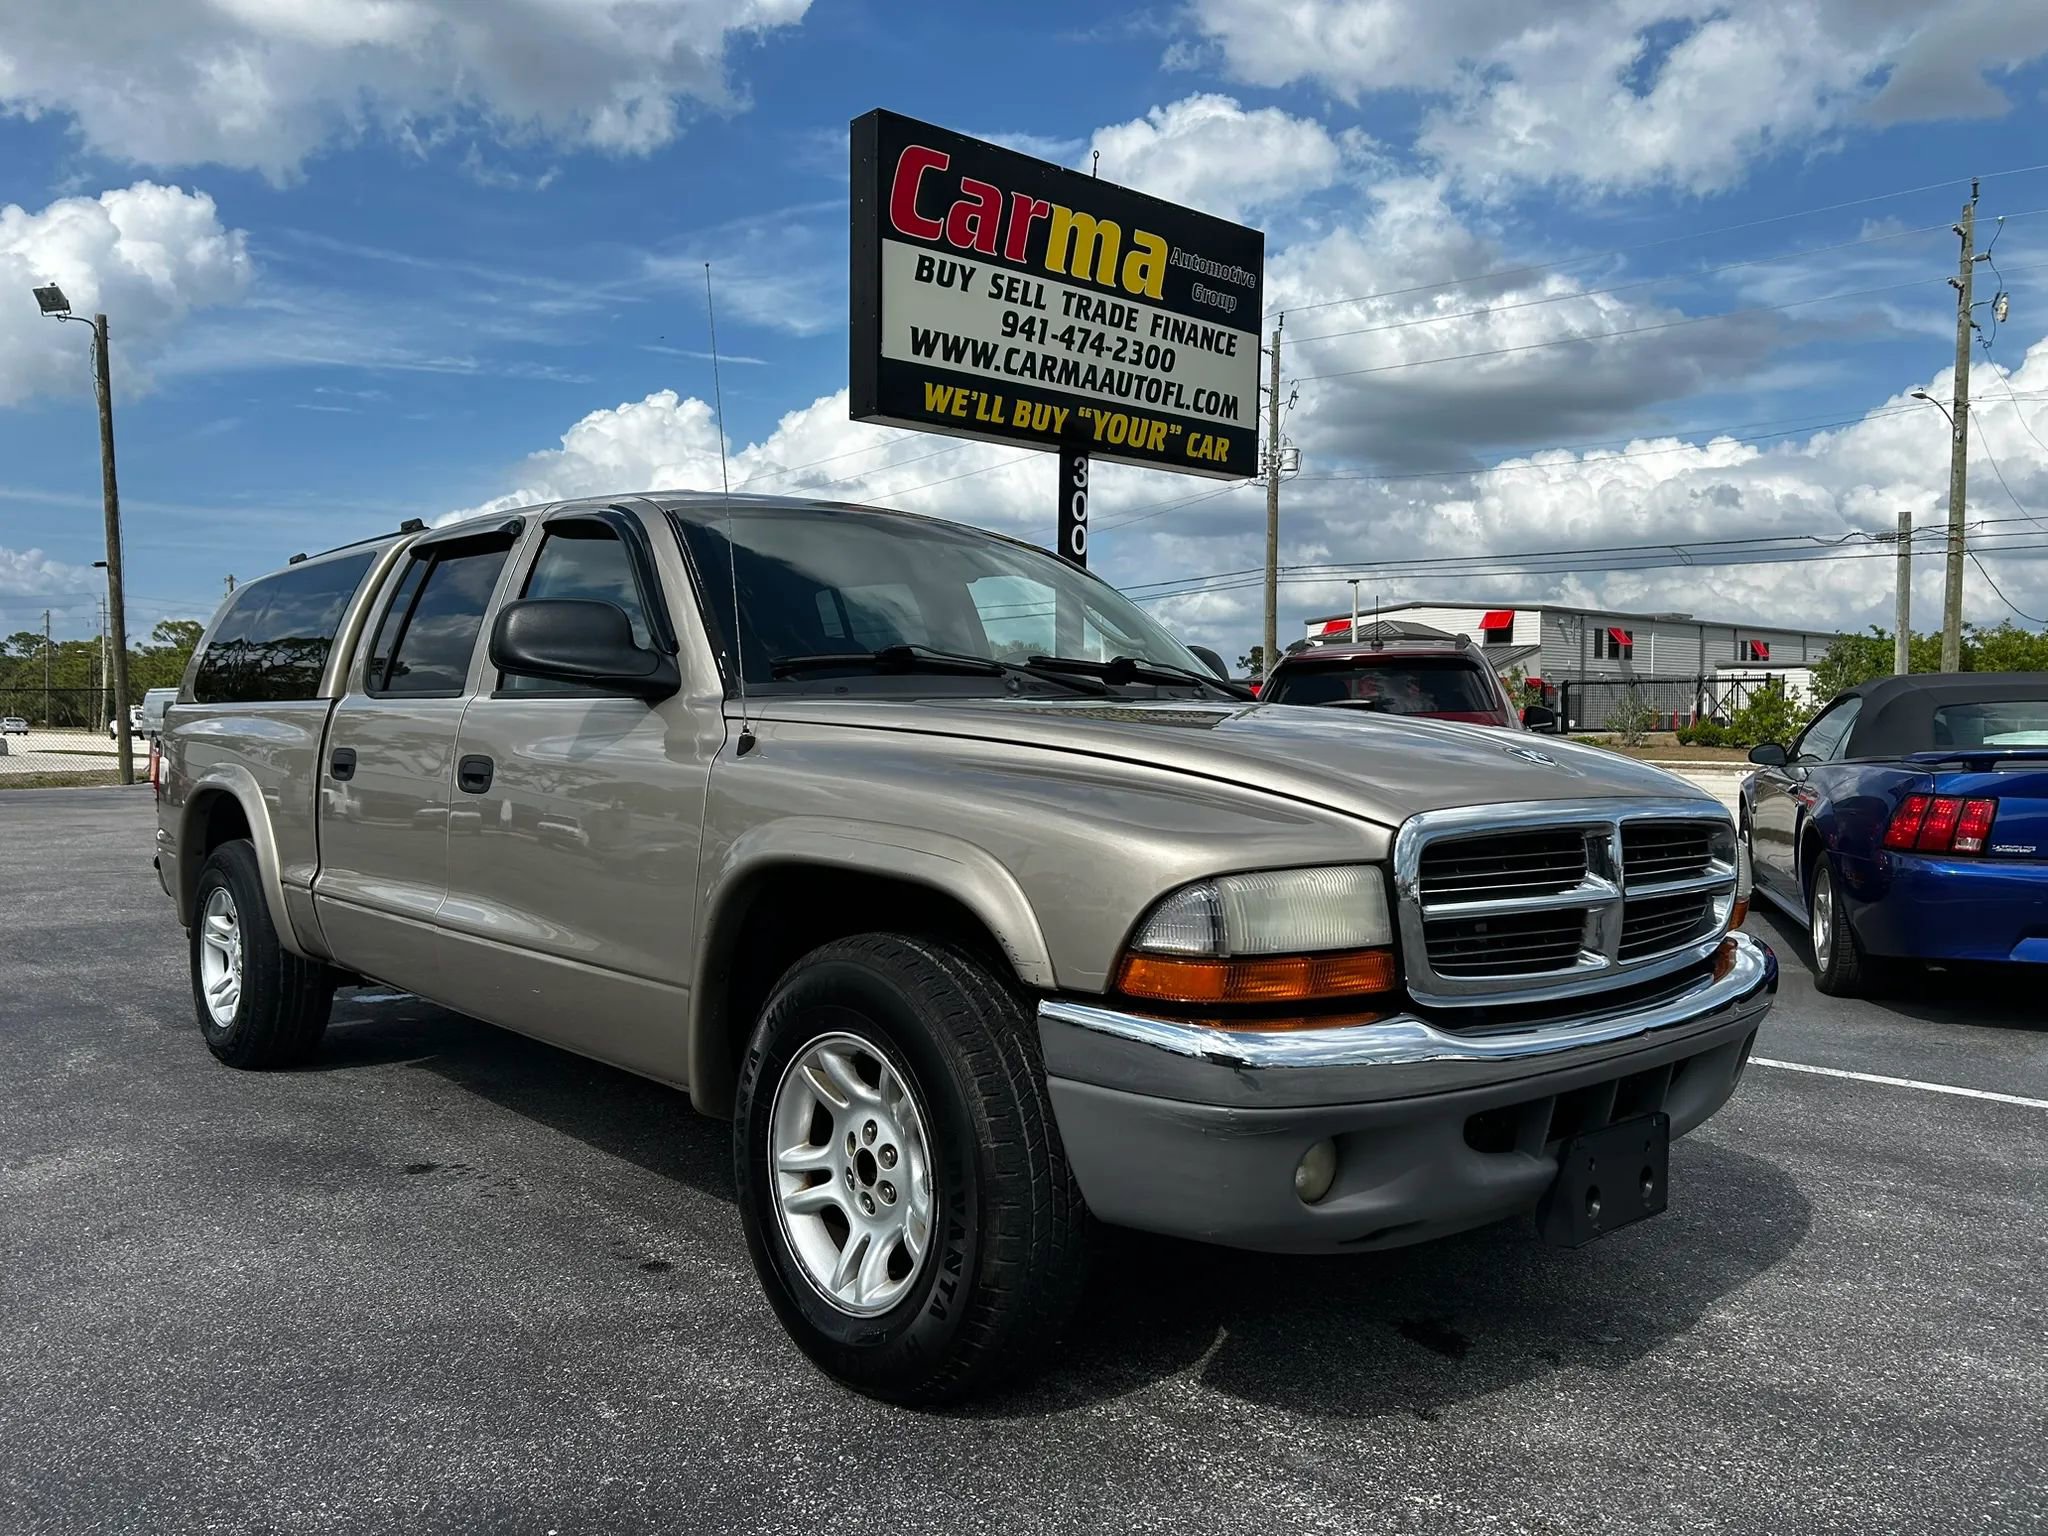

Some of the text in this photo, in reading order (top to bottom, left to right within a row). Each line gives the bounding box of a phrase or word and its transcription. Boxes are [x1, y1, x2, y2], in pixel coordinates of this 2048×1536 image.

[890, 144, 1168, 300] Carma
[914, 254, 1239, 357] BUY SELL TRADE FINANCE
[1169, 247, 1256, 288] Automotive
[1191, 282, 1237, 313] Group
[910, 326, 1239, 421] WWW.CARMAAUTOFL.COM
[1000, 310, 1176, 373] 941-474-2300
[924, 382, 1005, 424] WE’LL
[1012, 402, 1070, 435] BUY
[1186, 432, 1230, 463] CAR
[1071, 456, 1088, 555] 300
